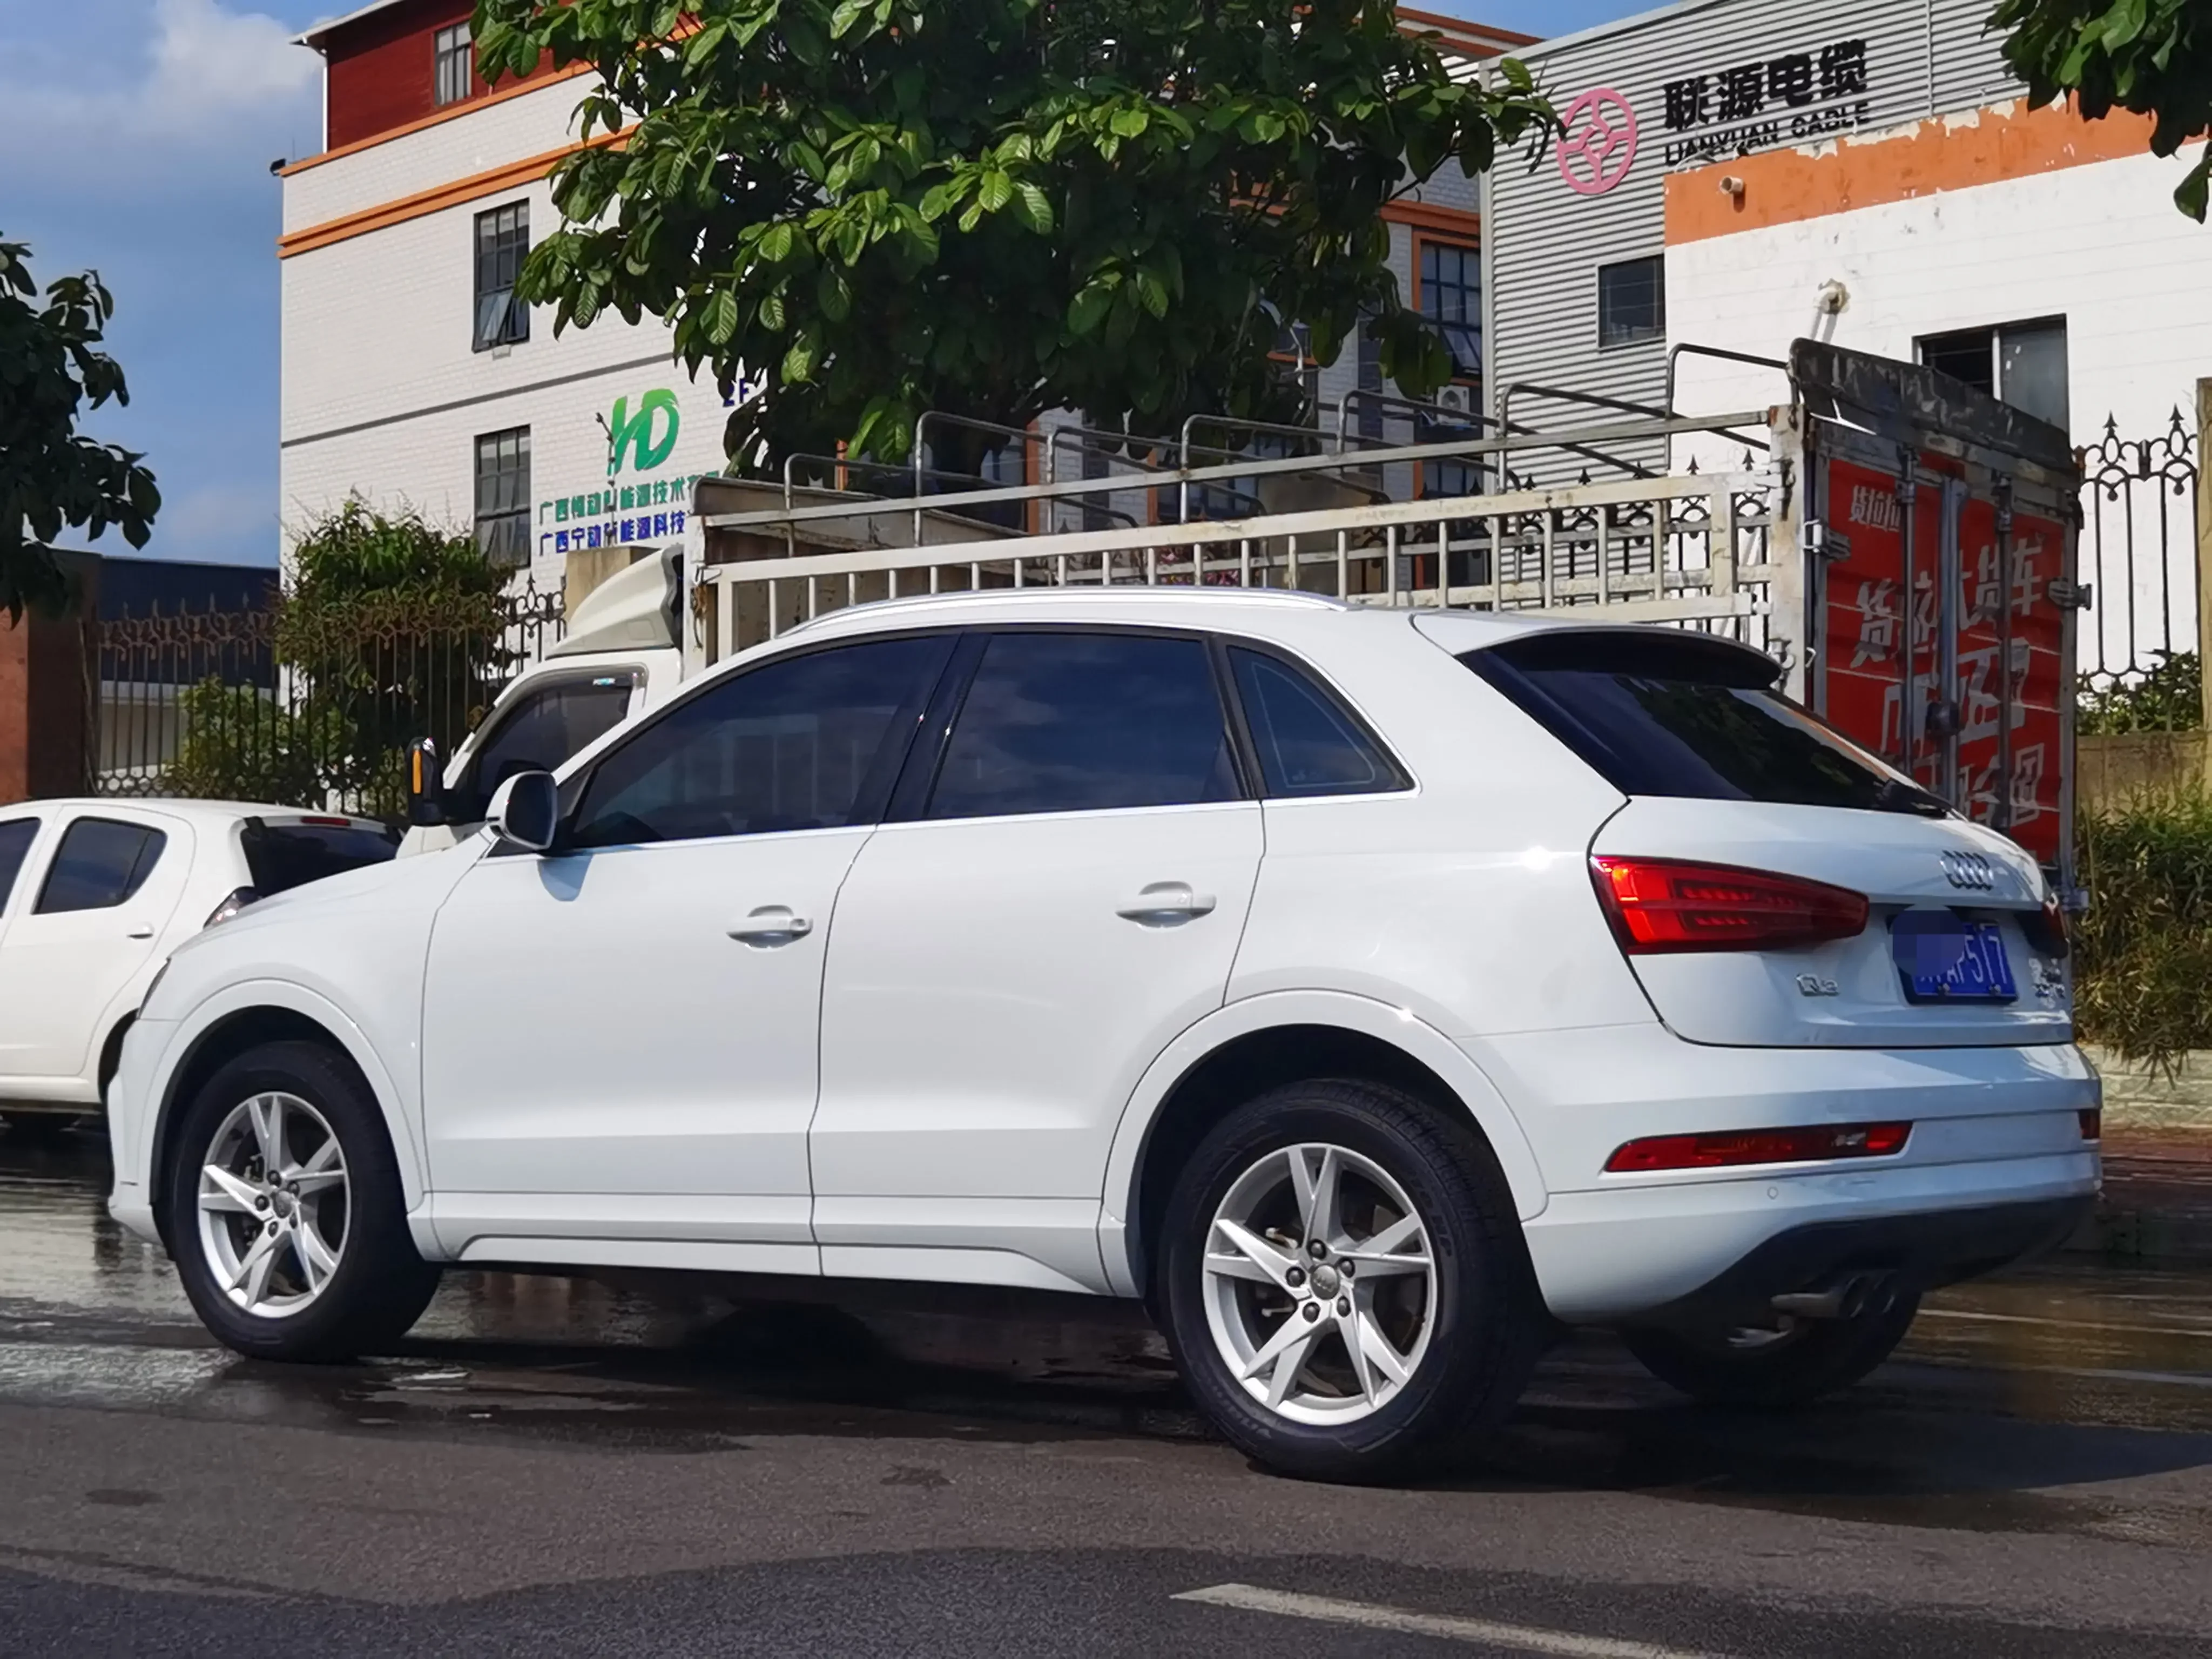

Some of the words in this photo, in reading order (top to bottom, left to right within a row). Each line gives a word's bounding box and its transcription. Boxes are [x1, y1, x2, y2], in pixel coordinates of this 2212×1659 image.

[1664, 39, 1867, 131] 联源电缆
[1791, 102, 1870, 138] CABLE
